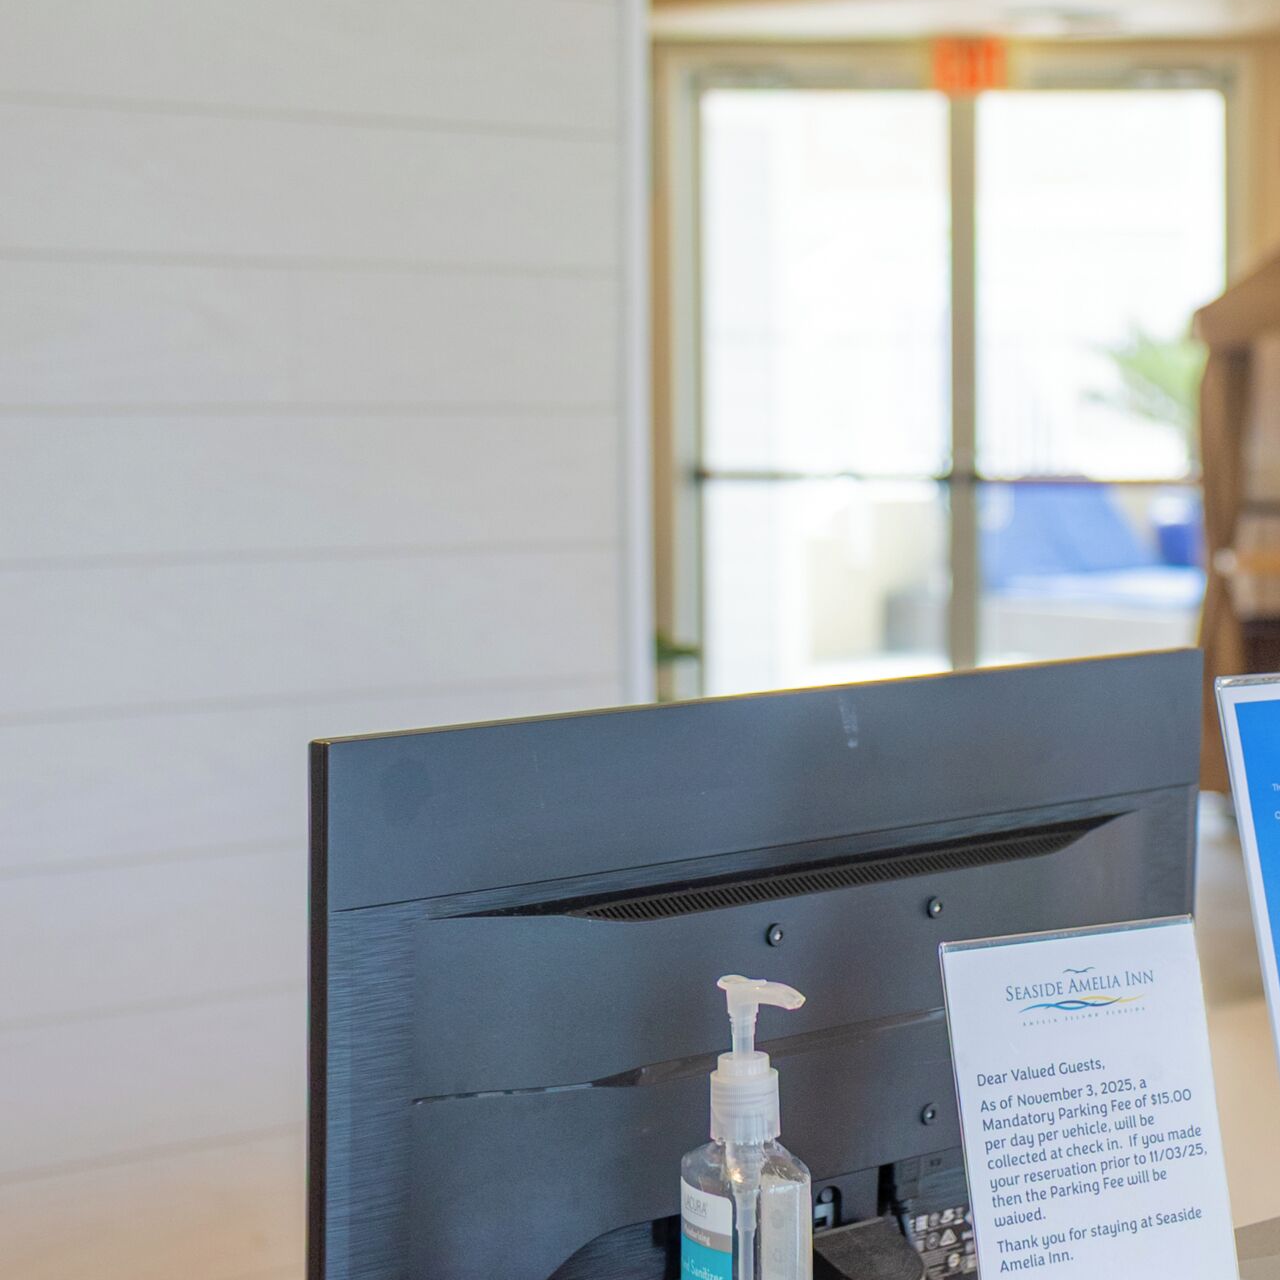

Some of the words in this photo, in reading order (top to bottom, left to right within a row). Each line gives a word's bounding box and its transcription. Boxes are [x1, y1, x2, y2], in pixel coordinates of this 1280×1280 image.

[1005, 981, 1063, 1002] SEASIDE
[1068, 975, 1121, 994] AMELIA
[1125, 970, 1154, 987] INN
[977, 1073, 1008, 1087] Dear
[1011, 1064, 1056, 1081] Valued
[1058, 1059, 1105, 1075] Guests,
[981, 1100, 996, 1112] As
[1000, 1095, 1012, 1109] of
[1017, 1087, 1082, 1107] November
[1086, 1084, 1098, 1096] 3,
[1100, 1078, 1136, 1095] 2025,
[1140, 1078, 1147, 1088] a
[982, 1112, 1054, 1132] Mandatory
[1058, 1103, 1108, 1120] Parking
[1111, 1099, 1132, 1112] Fee
[1135, 1094, 1147, 1108] of
[1151, 1088, 1192, 1106] $15.00
[985, 1138, 1006, 1154] per
[1010, 1134, 1034, 1148] day
[1038, 1130, 1058, 1146] per
[1062, 1121, 1112, 1139] vehicle,
[1114, 1116, 1136, 1130] will
[1140, 1114, 1154, 1126] be
[988, 1148, 1047, 1170] collected
[1050, 1147, 1063, 1160] at
[1066, 1140, 1104, 1157] check
[1107, 1138, 1122, 1150] in.
[1128, 1134, 1138, 1147] If
[1142, 1133, 1164, 1148] you
[1168, 1125, 1202, 1140] made
[990, 1174, 1020, 1192] your
[1024, 1162, 1097, 1184] reservation
[1100, 1153, 1130, 1174] prior
[1134, 1154, 1146, 1166] to
[1150, 1142, 1208, 1163] 11/03/25,
[992, 1194, 1022, 1208] then
[1026, 1188, 1047, 1202] the
[1050, 1180, 1100, 1198] Parking
[1103, 1176, 1124, 1190] Fee
[1127, 1170, 1150, 1186] will
[1152, 1168, 1167, 1181] be
[994, 1206, 1046, 1228] waived.
[997, 1235, 1039, 1253] Thank
[1042, 1231, 1066, 1250] you
[1069, 1227, 1087, 1241] for
[1090, 1219, 1138, 1239] staying
[1140, 1216, 1153, 1228] at
[1155, 1206, 1202, 1226] Seaside
[1000, 1253, 1046, 1272] Amelia
[1049, 1250, 1074, 1264] Inn.
